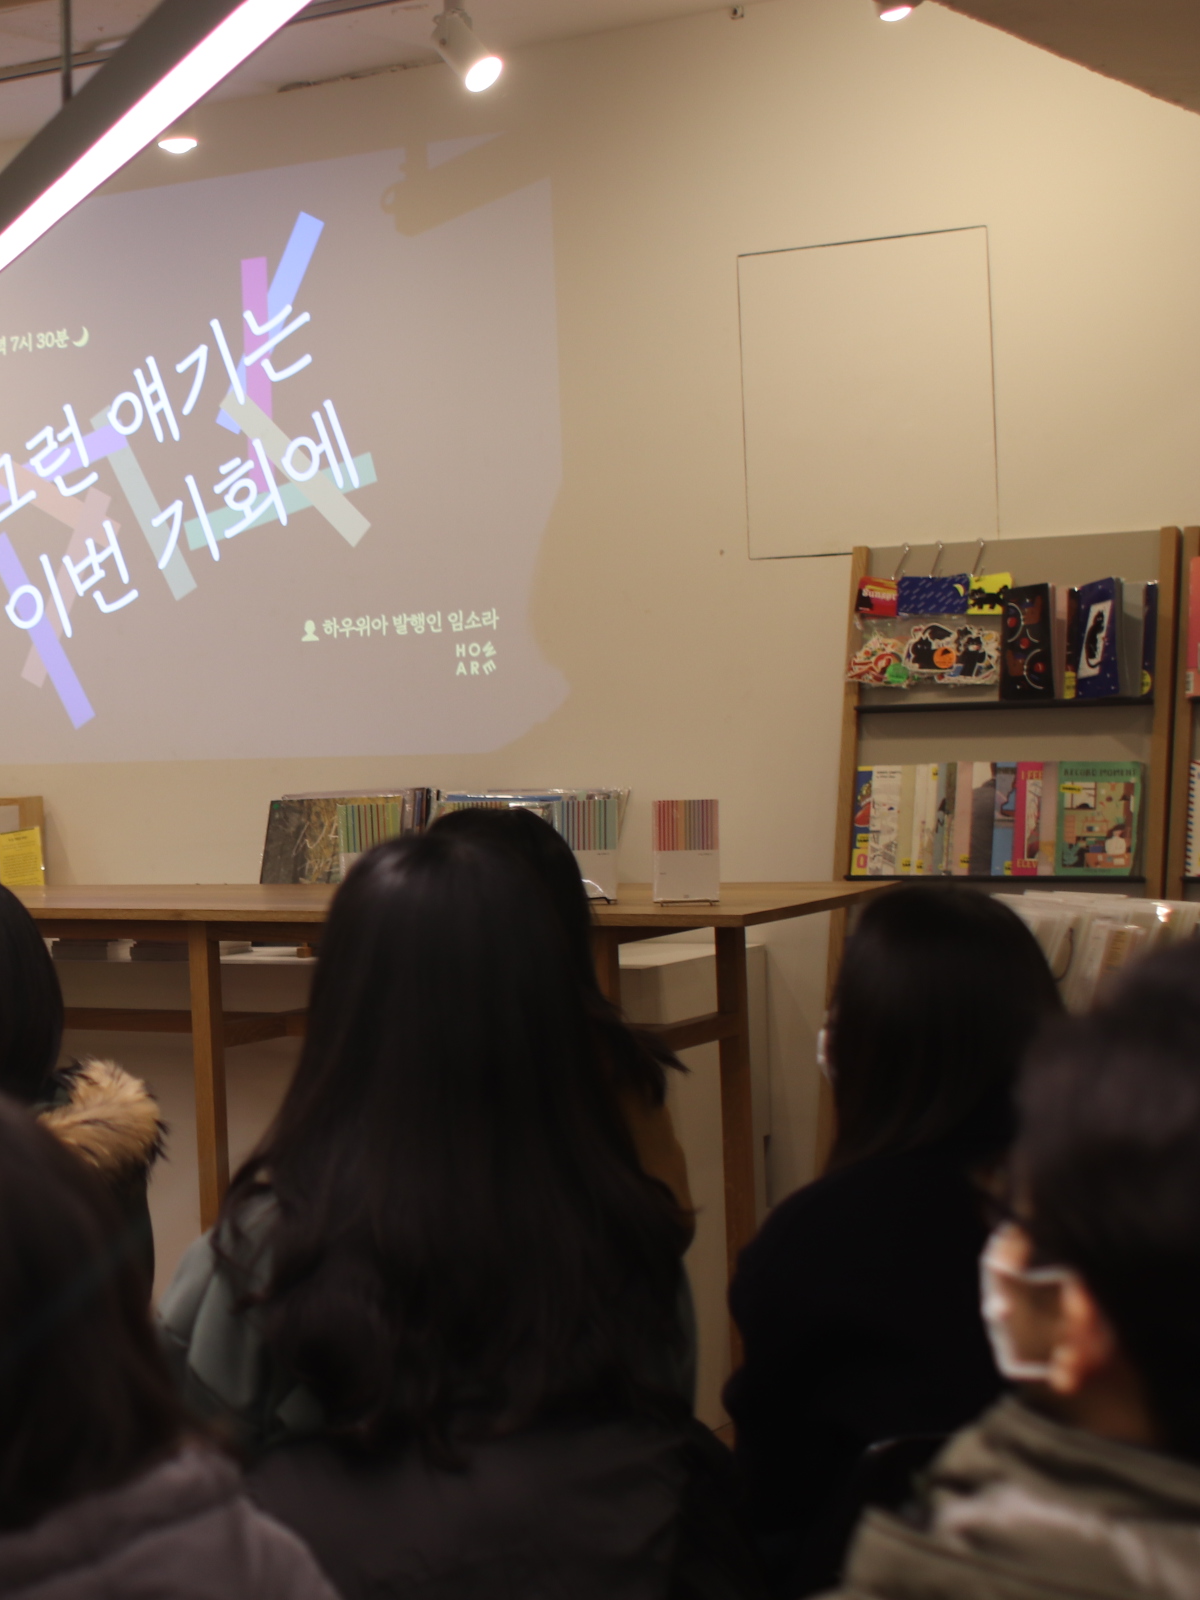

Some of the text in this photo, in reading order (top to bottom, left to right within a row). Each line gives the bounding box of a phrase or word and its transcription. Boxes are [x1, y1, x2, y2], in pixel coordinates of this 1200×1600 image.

[10, 332, 33, 352] 7시
[36, 328, 70, 349] 30분
[107, 304, 312, 443] 얘기는
[4, 399, 360, 638] 이번 기회에
[861, 588, 898, 601] Sunset
[322, 607, 500, 639] 하우위아 발행인 임소라
[1064, 768, 1137, 777] RECORD MOMENT
